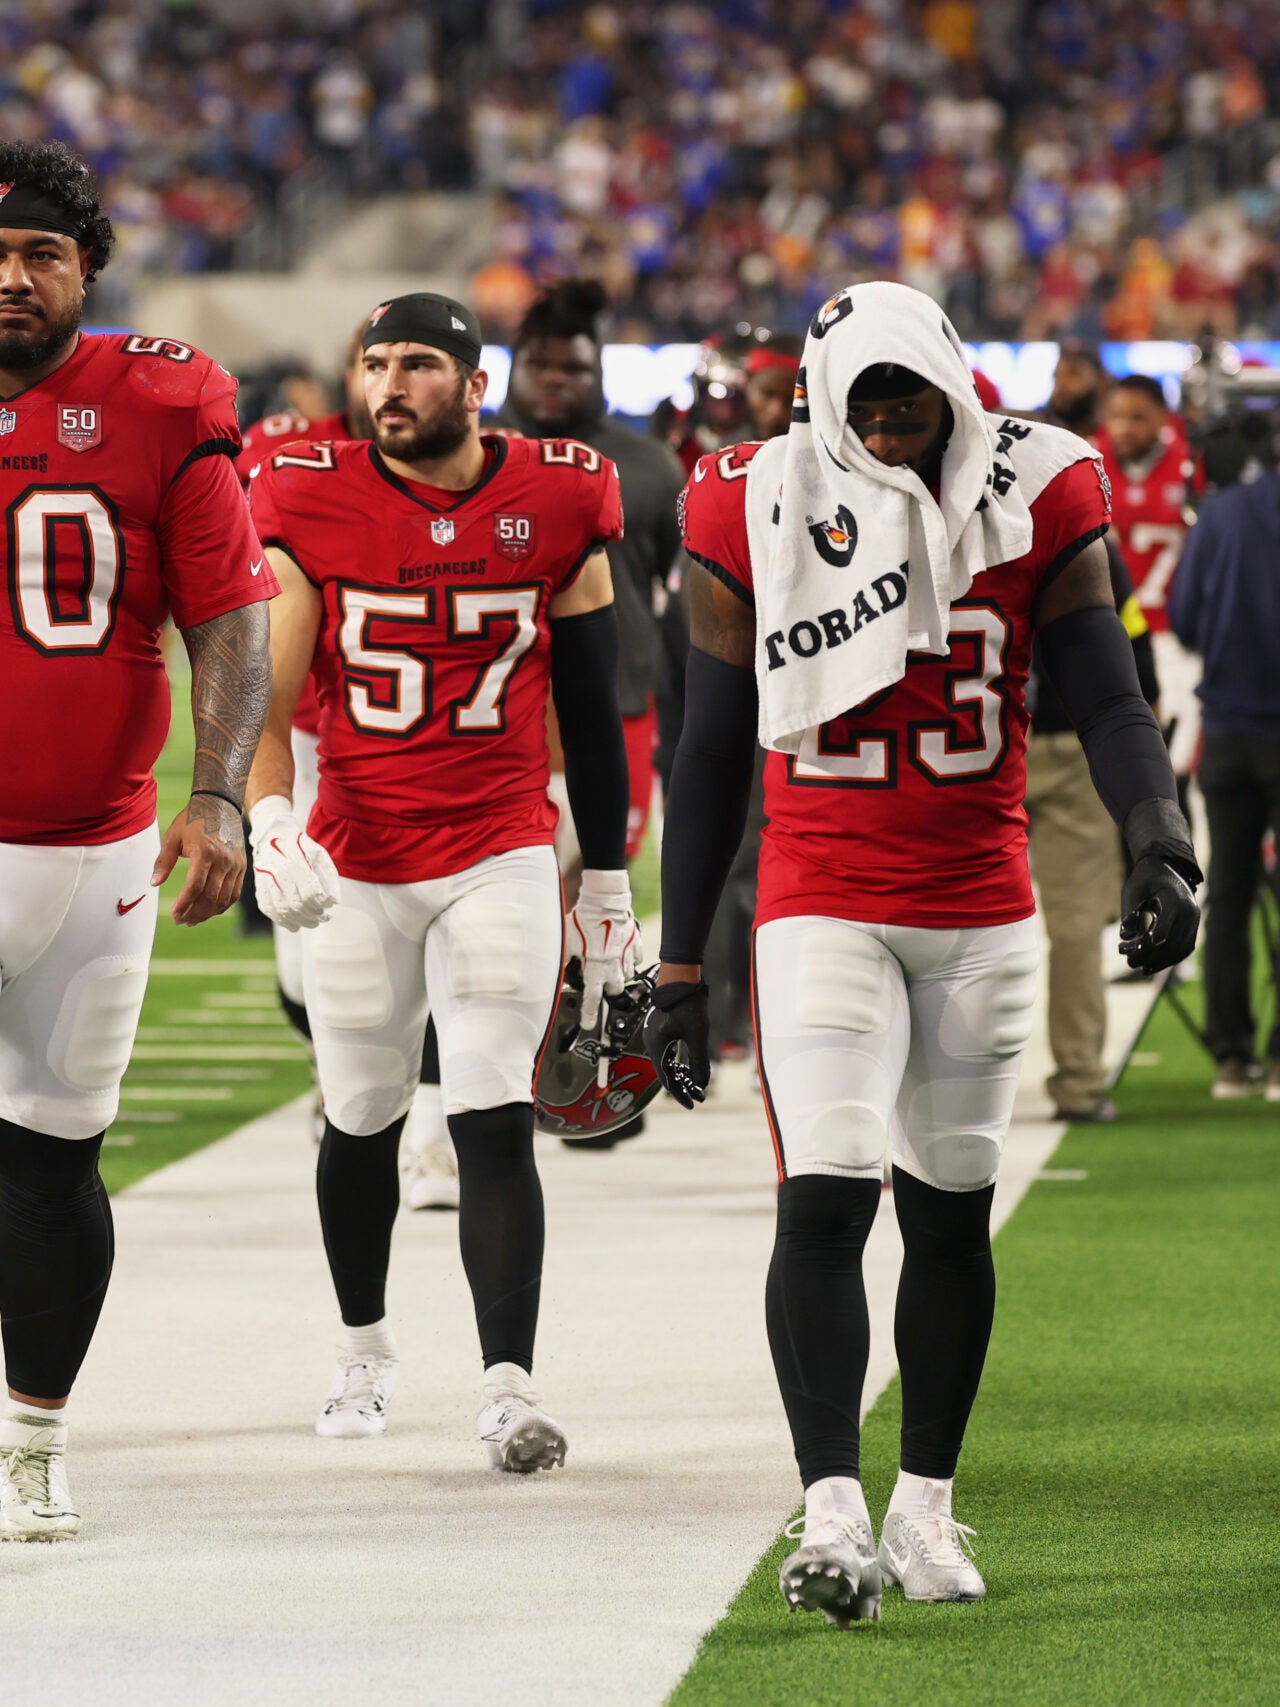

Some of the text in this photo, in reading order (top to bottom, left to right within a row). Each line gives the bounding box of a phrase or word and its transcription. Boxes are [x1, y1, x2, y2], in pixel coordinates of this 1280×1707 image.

[61, 408, 97, 431] 50
[498, 518, 531, 540] 50
[398, 557, 488, 585] BUCCANEERS
[765, 559, 909, 672] TORAD
[334, 579, 549, 740] 57
